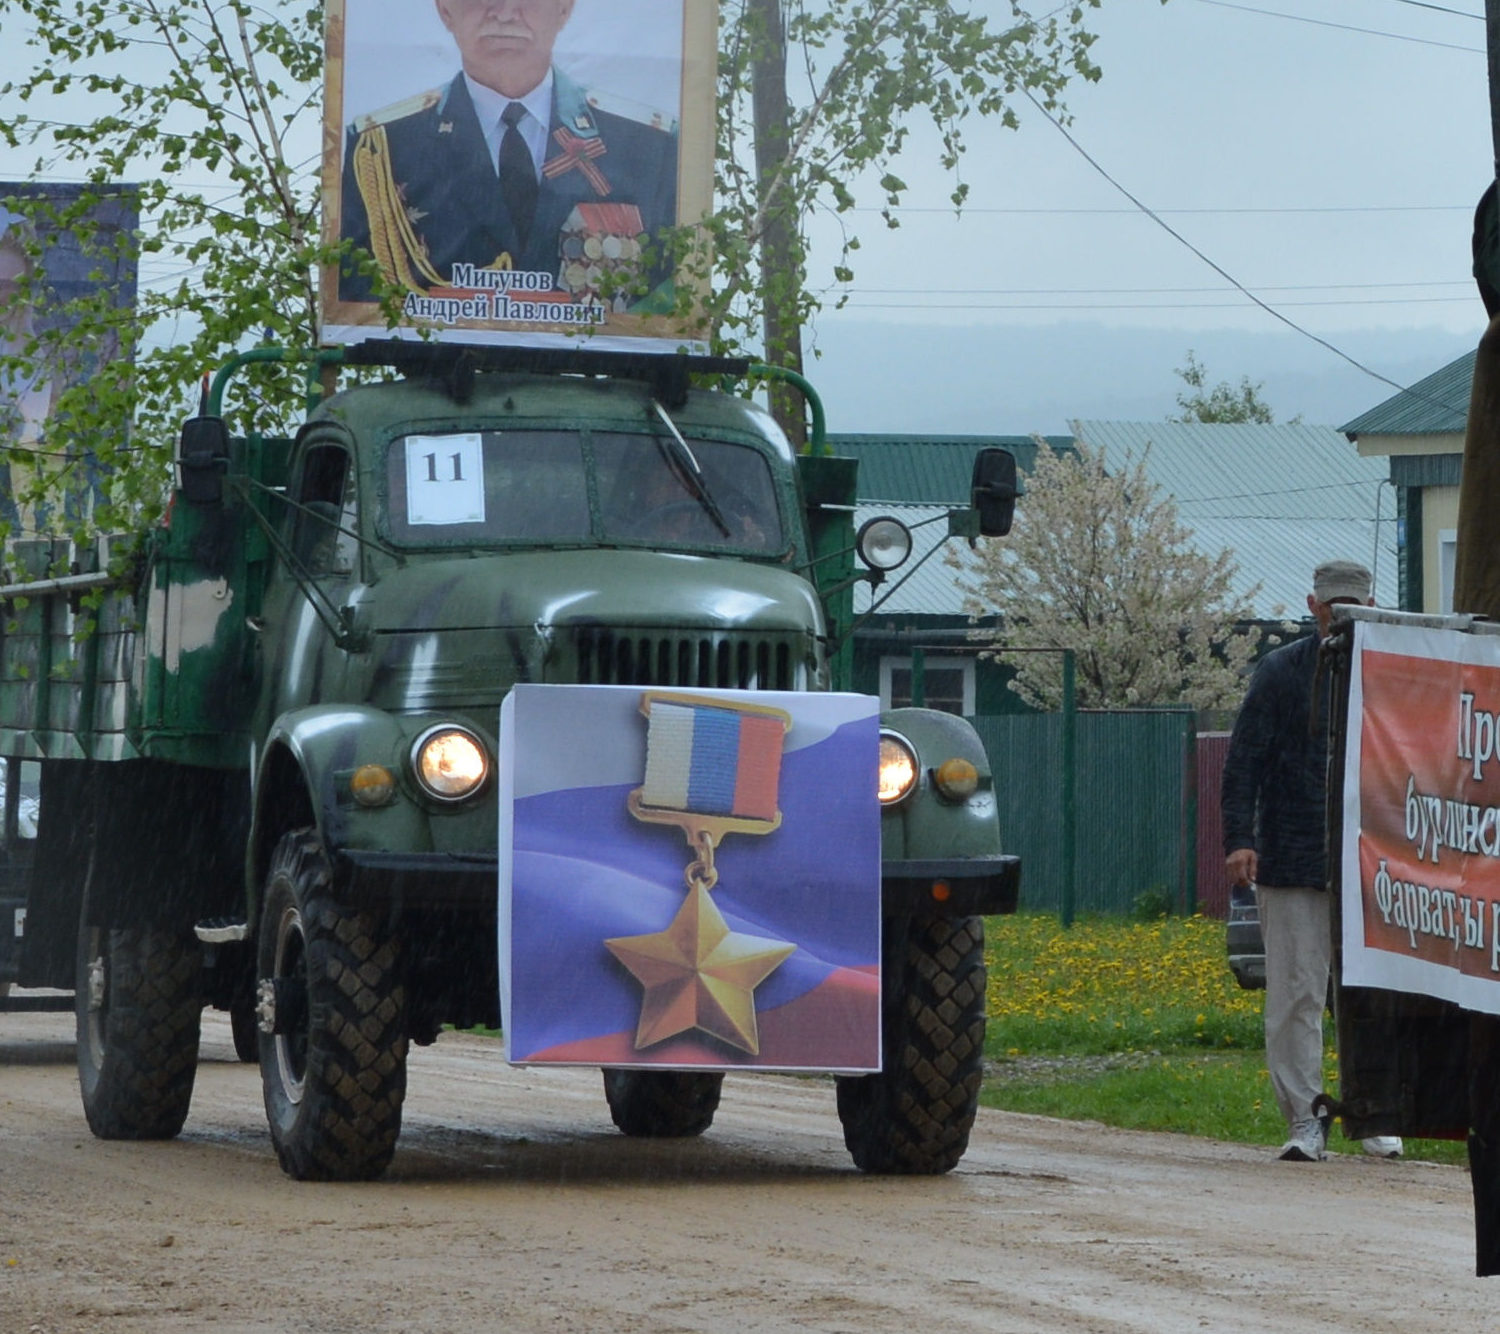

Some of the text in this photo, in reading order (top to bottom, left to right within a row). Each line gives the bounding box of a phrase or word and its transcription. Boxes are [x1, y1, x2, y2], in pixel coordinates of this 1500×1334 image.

[452, 263, 552, 294] Мигунов
[404, 294, 606, 323] Андрей Павлович
[422, 452, 467, 482] 11
